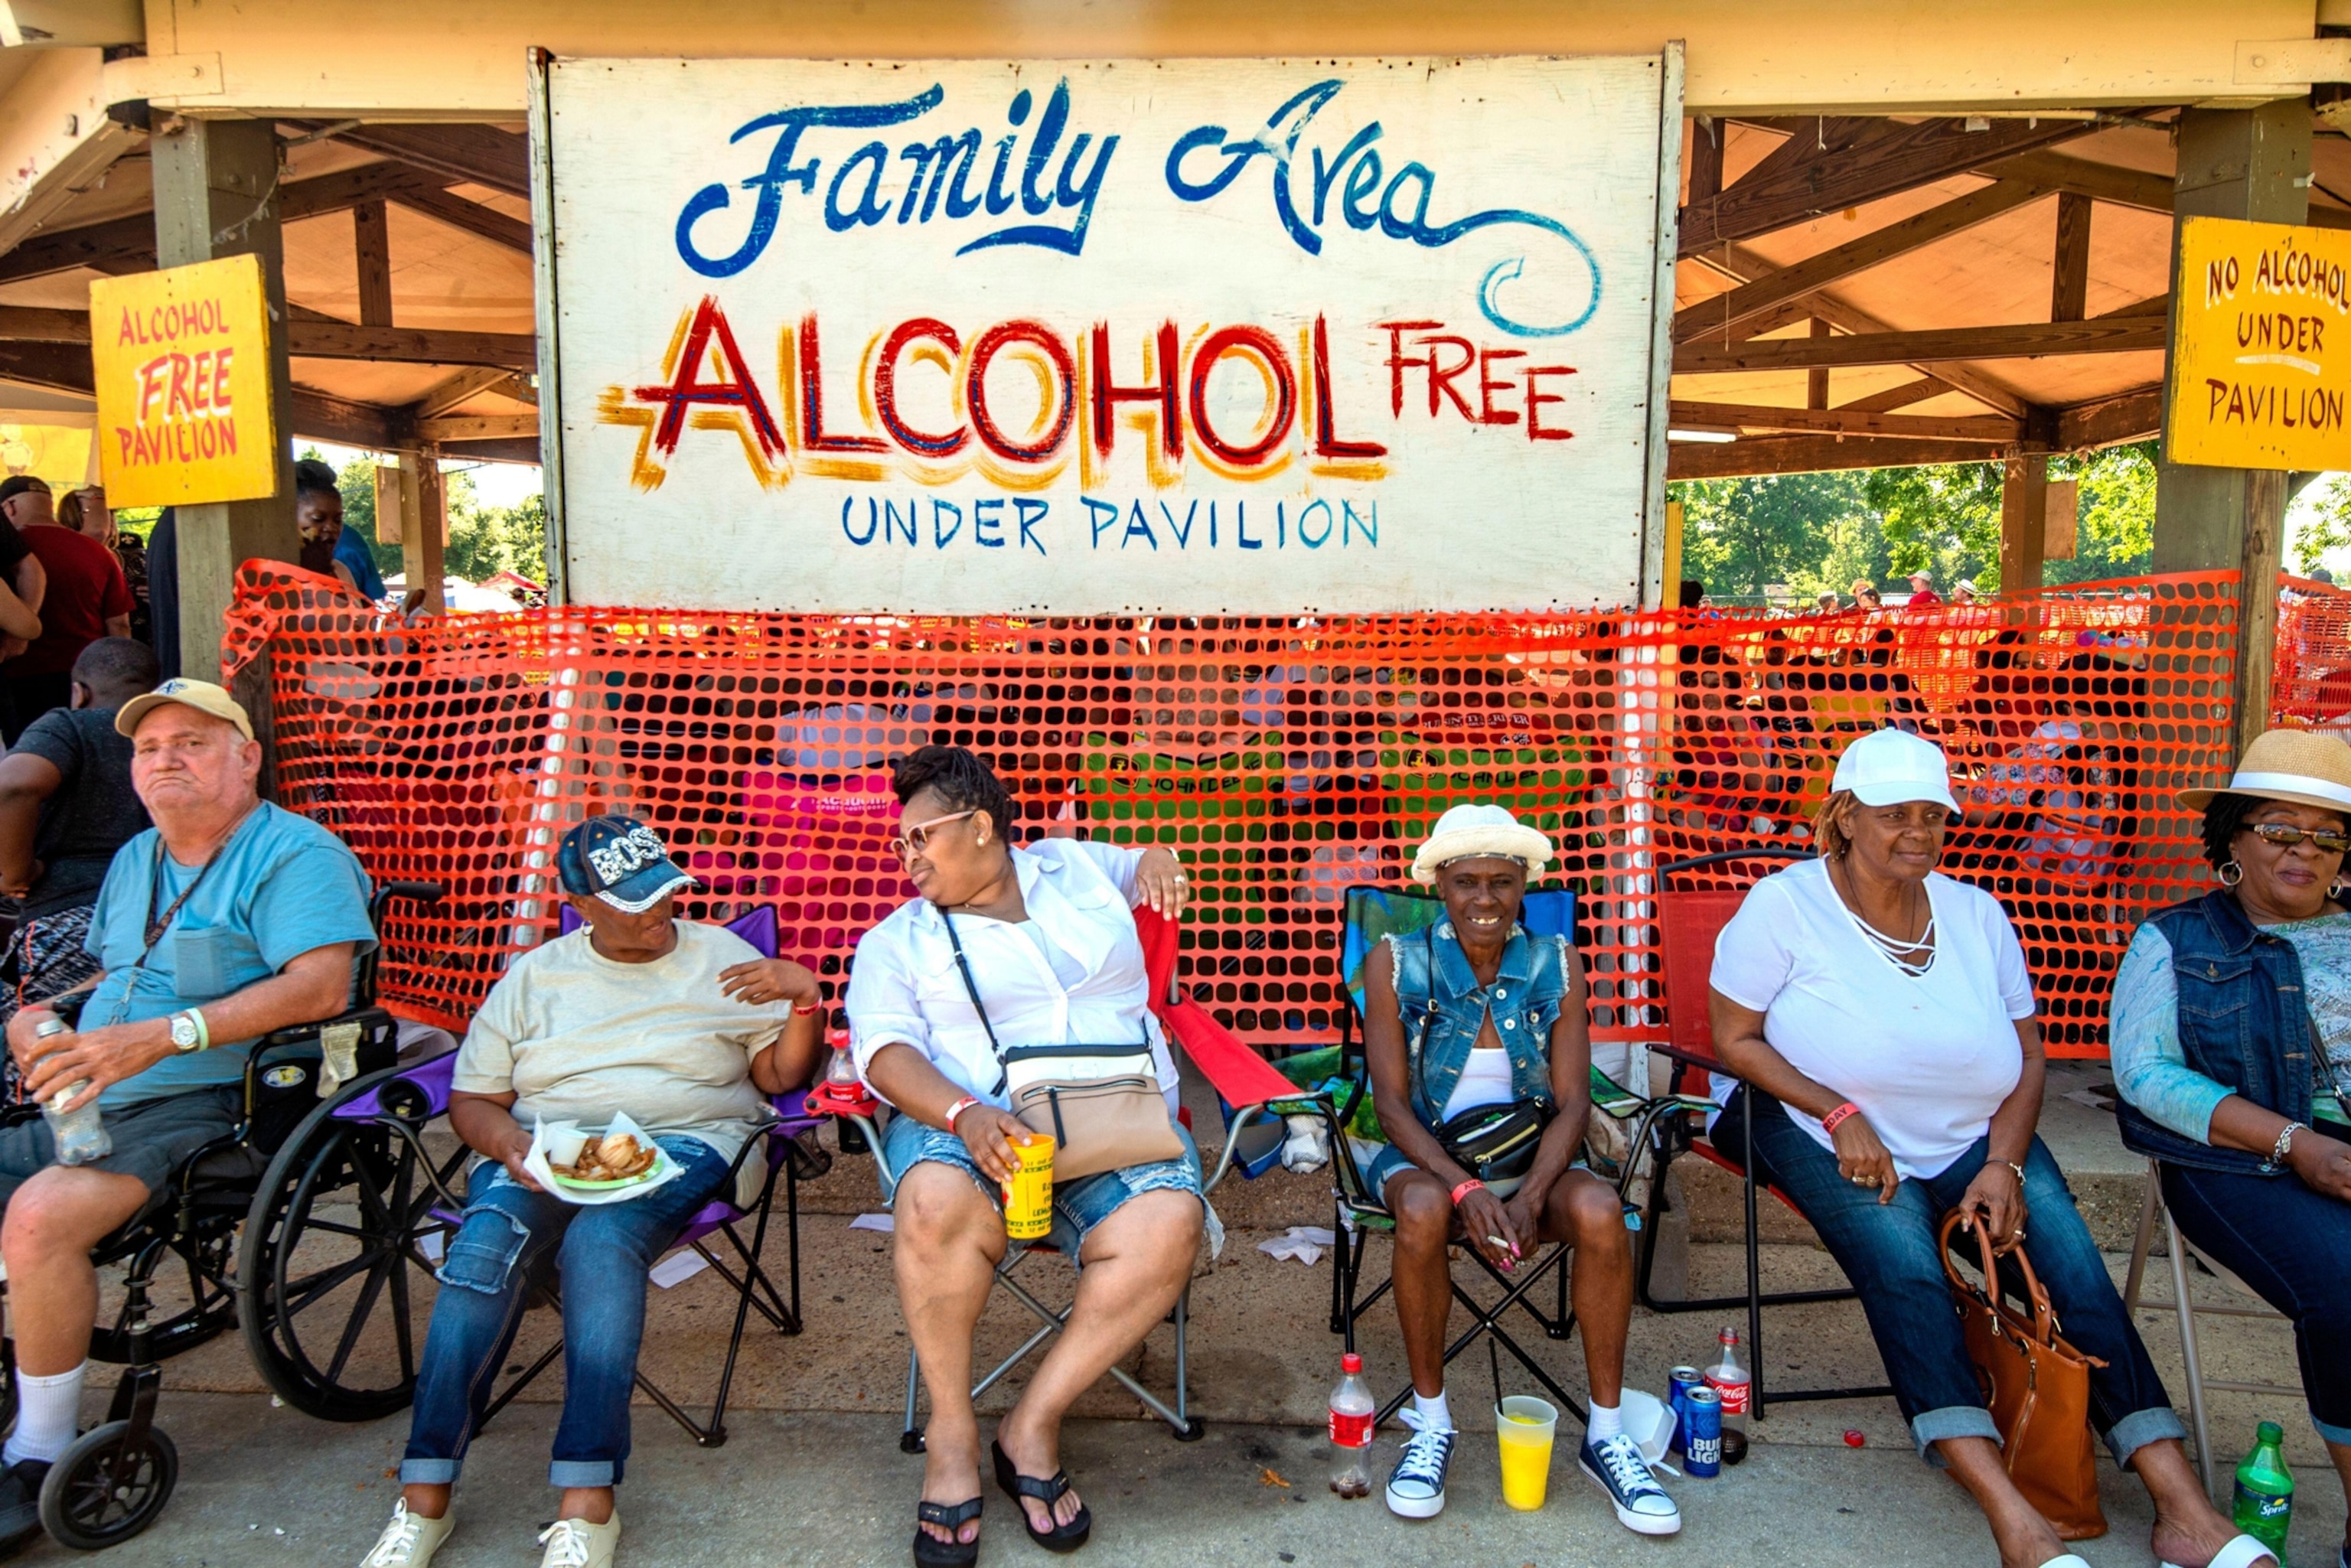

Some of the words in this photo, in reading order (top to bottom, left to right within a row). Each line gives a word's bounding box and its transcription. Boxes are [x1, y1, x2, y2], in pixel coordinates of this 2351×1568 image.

[674, 76, 1121, 278] Family
[2207, 255, 2239, 299] NO
[2256, 249, 2350, 311] ALCOHOL
[119, 298, 230, 348] ALCOHOL
[2237, 311, 2325, 354] UNDER
[138, 347, 234, 425] FREE
[629, 295, 1387, 466] ALCOHOL
[1378, 320, 1580, 442] FREE
[2205, 378, 2344, 432] PAVILION
[116, 417, 238, 468] PAVILION
[842, 496, 1047, 556] UNDER
[1080, 496, 1380, 559] PAVILION
[1687, 1446, 1722, 1465] LIGH
